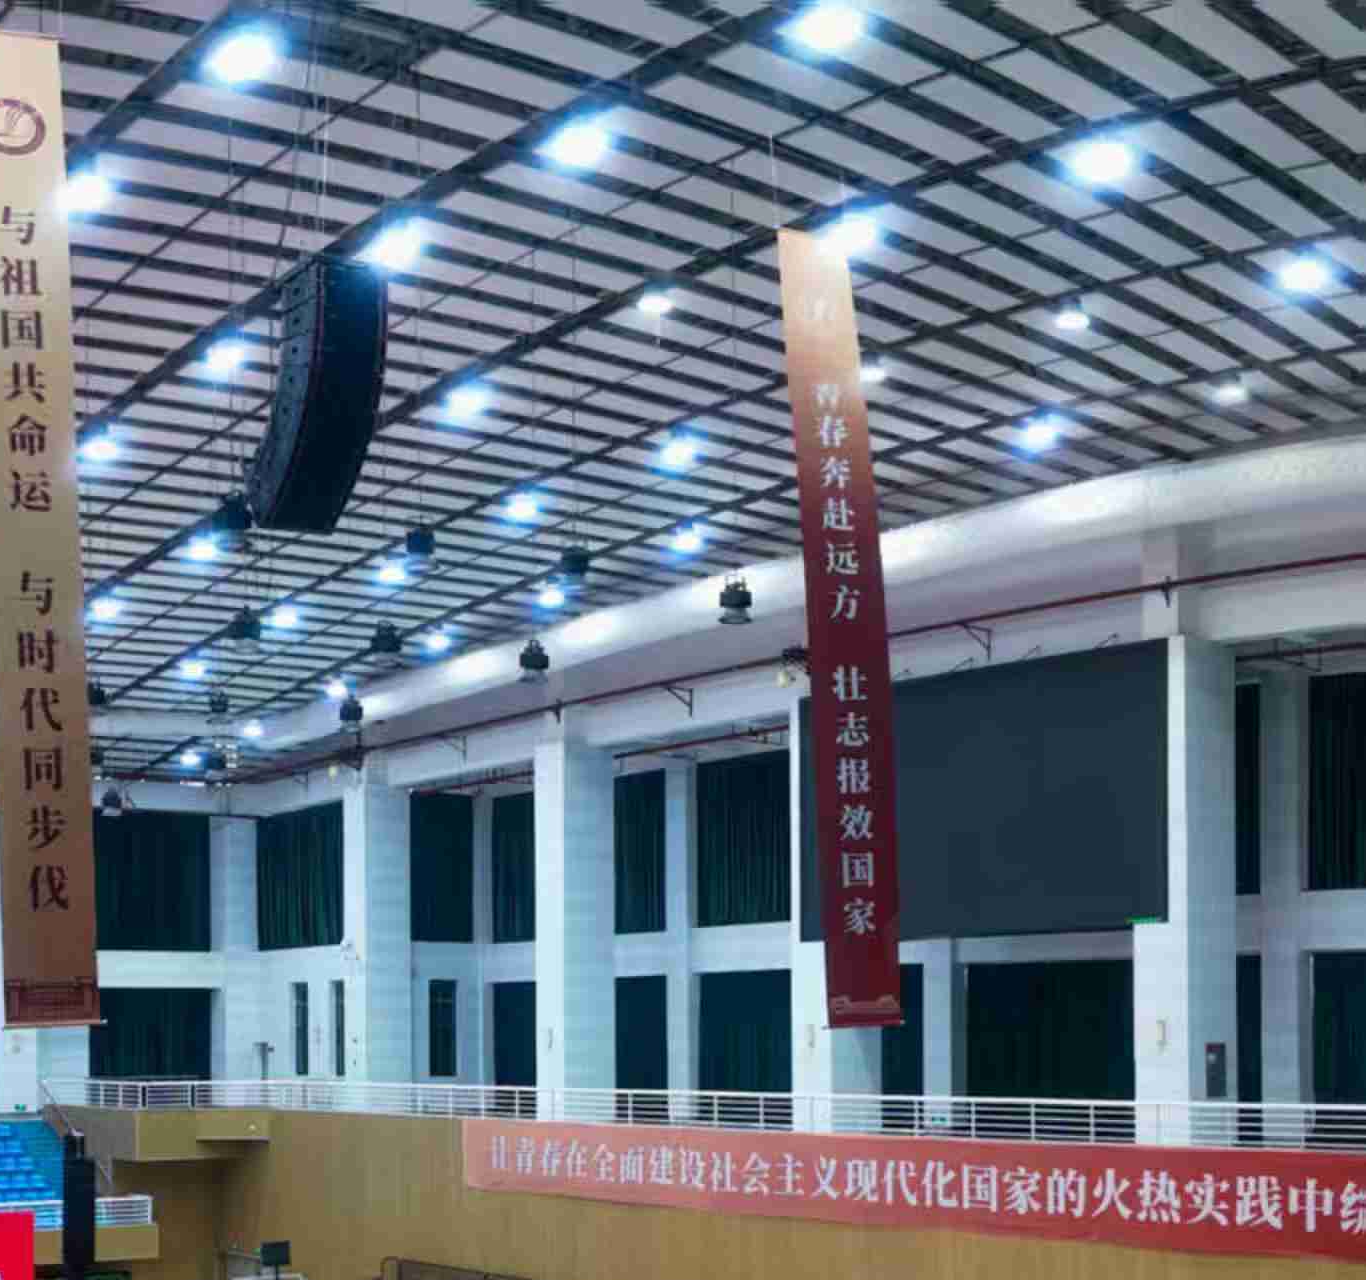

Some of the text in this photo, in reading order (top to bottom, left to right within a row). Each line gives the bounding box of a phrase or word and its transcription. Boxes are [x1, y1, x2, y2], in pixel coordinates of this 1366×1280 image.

[16, 570, 71, 912] 与时代同步伐
[832, 664, 876, 936] 壮志报效国家
